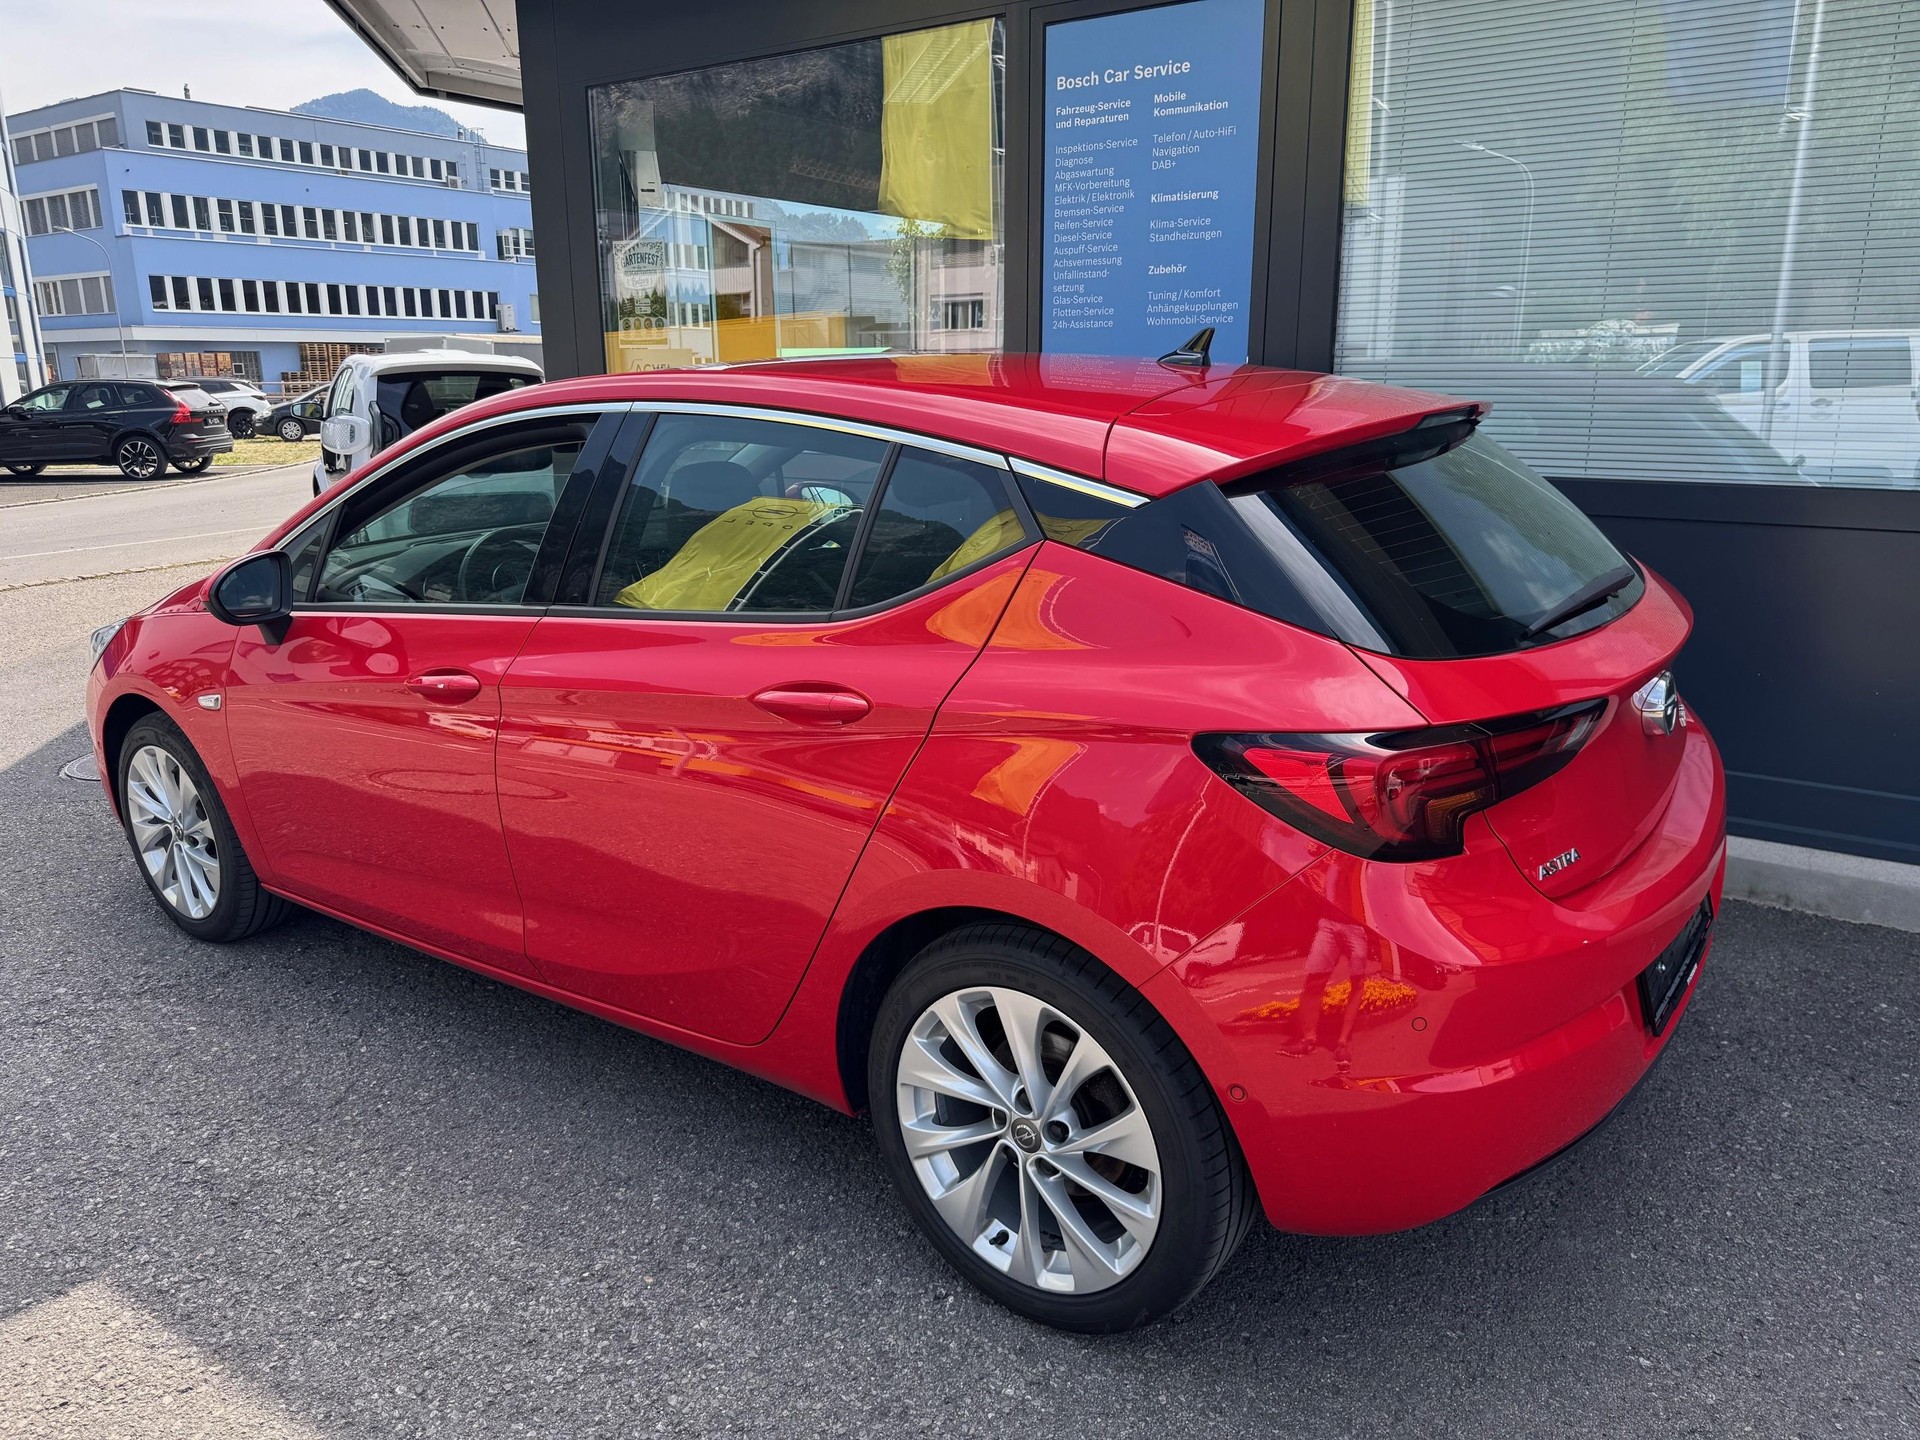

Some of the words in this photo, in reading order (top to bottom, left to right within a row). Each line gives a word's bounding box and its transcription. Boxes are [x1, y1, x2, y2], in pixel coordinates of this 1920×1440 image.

[1057, 72, 1099, 90] Bosch
[1104, 69, 1129, 83] Car
[1134, 60, 1191, 80] Service
[1154, 91, 1186, 103] Mobile
[1056, 99, 1131, 116] Fahrzeug-Service
[1153, 100, 1228, 117] Kommunikation
[1056, 118, 1071, 129] und
[1074, 113, 1129, 129] Reparaturen
[1055, 138, 1138, 157] Inspektions-Service
[1152, 144, 1200, 158] Navigation
[1055, 156, 1093, 168] Diagnose
[1152, 160, 1176, 170] DAB+
[1055, 166, 1114, 181] Abgaswartung
[1055, 178, 1130, 193] MFK-Vorbereitung
[1151, 189, 1219, 203] Klimatisierung
[1055, 204, 1124, 218] Bremsen-Service
[1054, 218, 1113, 230] Reifen-Service
[1150, 216, 1211, 229] Klima-Service
[1054, 231, 1112, 243] Diesel-Service
[1149, 230, 1222, 243] Standheizungen
[1054, 243, 1118, 257] Auspuff-Service
[621, 252, 659, 268] GARTENFEST
[1053, 255, 1122, 268] Achsvermessung
[1053, 269, 1110, 280] Unfallinstand-
[1149, 264, 1187, 275] Zubehör
[1053, 283, 1084, 293] setzung
[1053, 294, 1103, 305] Glas-Service
[1053, 307, 1114, 317] Flotten-Service
[1147, 302, 1239, 314] Anhängekupplungen
[1053, 320, 1113, 330] 24h-Assistance
[1147, 314, 1233, 326] Wohnmobil-Service
[1538, 847, 1581, 881] ASTRA
